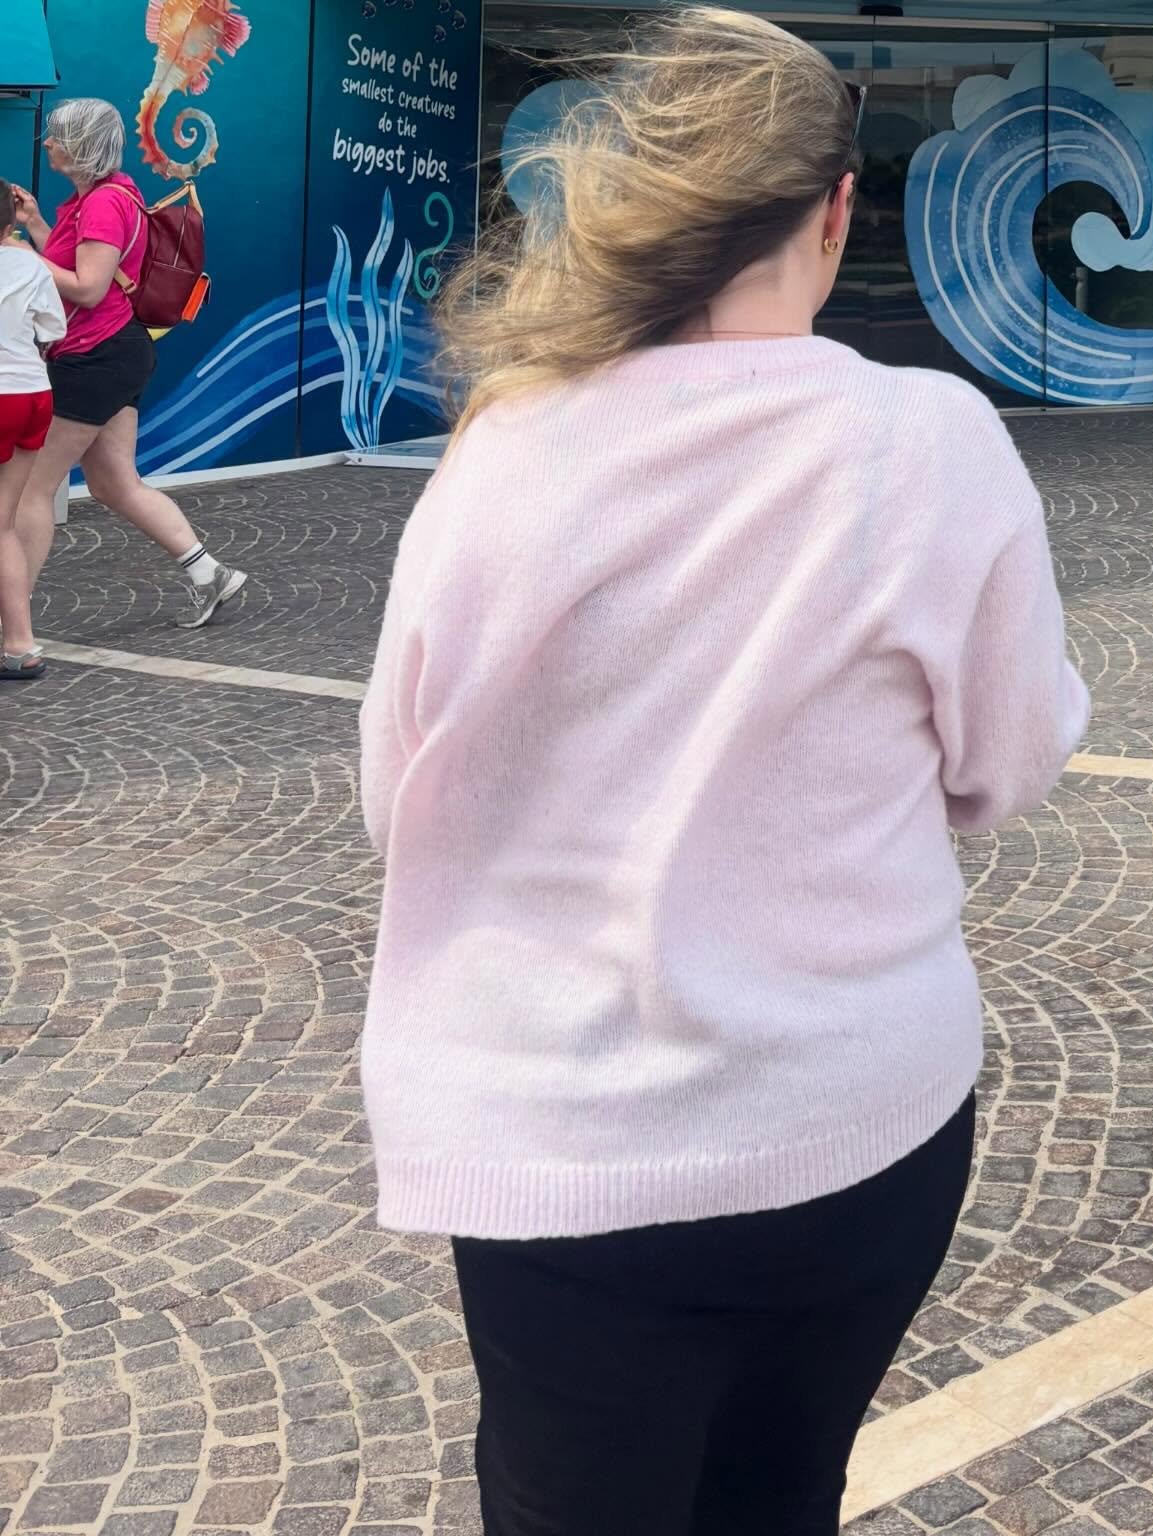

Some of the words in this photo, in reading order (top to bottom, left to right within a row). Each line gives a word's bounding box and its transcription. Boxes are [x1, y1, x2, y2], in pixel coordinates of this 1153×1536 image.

[347, 33, 396, 75] Some
[402, 51, 424, 83] of
[429, 58, 458, 91] the
[341, 77, 394, 105] smallest
[398, 90, 456, 120] creatures
[378, 111, 393, 133] do
[397, 116, 417, 138] the
[332, 127, 406, 176] biggest
[407, 149, 451, 185] jobs.
